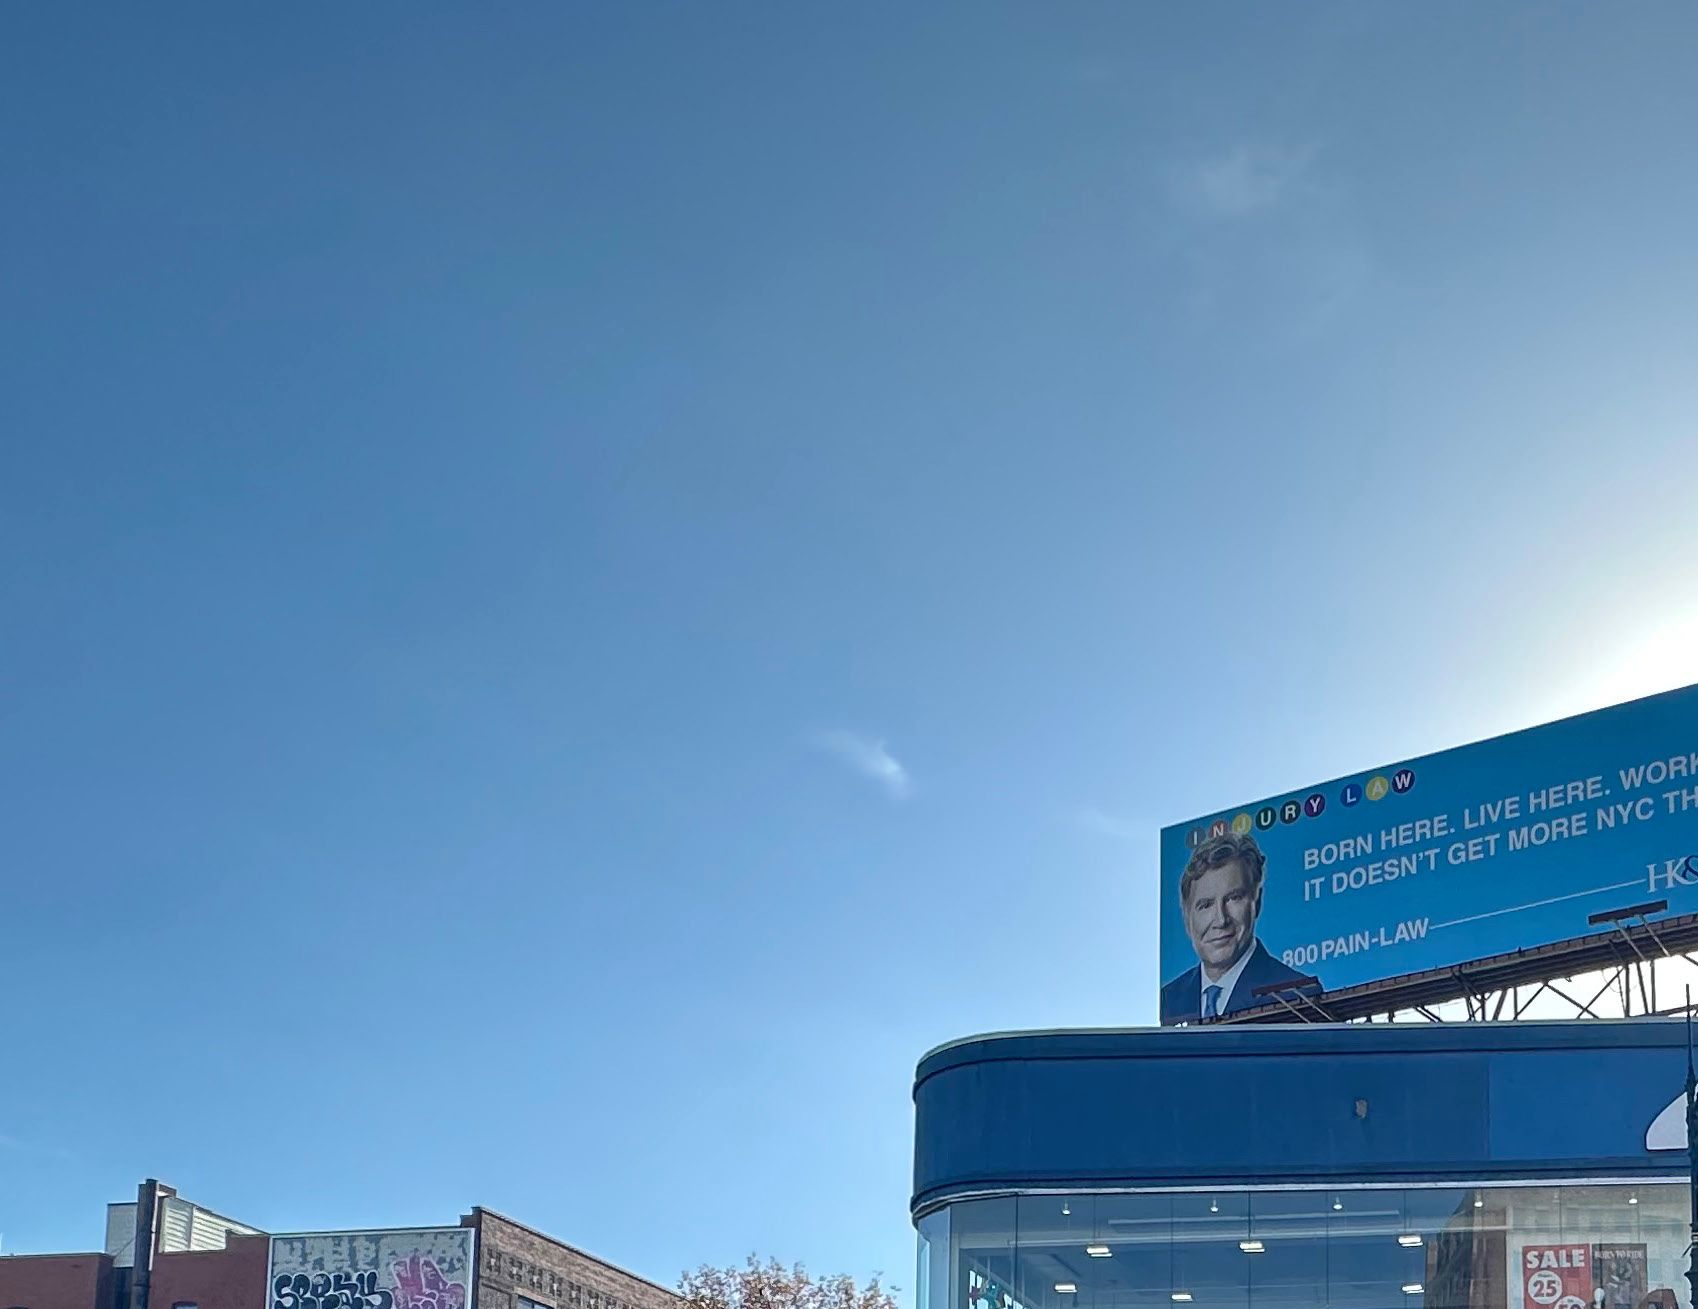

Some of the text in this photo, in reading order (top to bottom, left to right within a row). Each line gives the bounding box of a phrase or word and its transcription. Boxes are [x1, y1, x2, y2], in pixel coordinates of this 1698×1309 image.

[1188, 769, 1413, 847] INJURY LAW
[1304, 833, 1373, 870] BORN
[1381, 814, 1455, 850] HERE.
[1464, 796, 1520, 830] LIVE
[1529, 776, 1610, 814] HERE.
[1304, 877, 1325, 901] IT
[1333, 848, 1441, 895] DOESN'T
[1447, 833, 1500, 866] GET
[1508, 812, 1587, 852] MORE
[1597, 798, 1654, 831] NYC
[1321, 917, 1429, 960] PAIN-LAW
[1526, 1249, 1585, 1269] SALE
